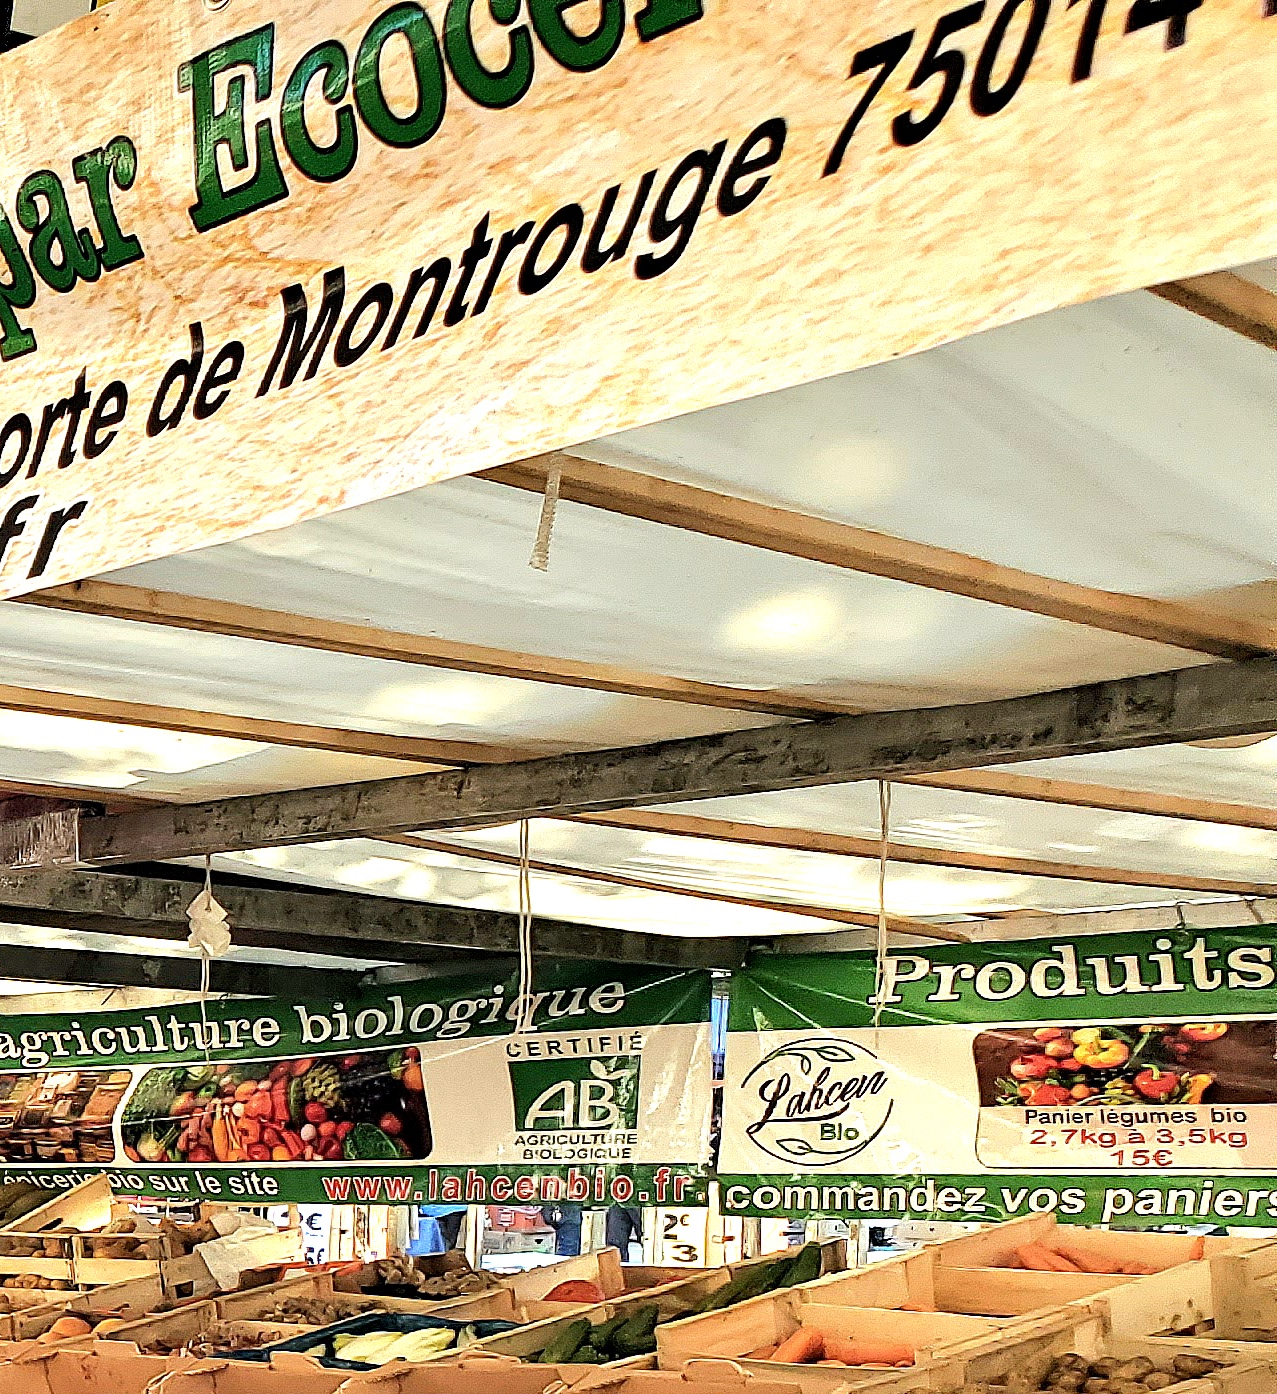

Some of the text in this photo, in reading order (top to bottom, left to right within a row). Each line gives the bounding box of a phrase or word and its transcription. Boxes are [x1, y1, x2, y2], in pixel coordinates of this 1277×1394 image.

[147, 322, 244, 438] de
[257, 115, 787, 398] Montrouge
[870, 937, 1276, 1003] Produits
[293, 980, 626, 1043] biologique
[507, 1031, 643, 1057] CERTIFIÉ
[524, 1079, 619, 1129] AB
[754, 1068, 888, 1126] Lahcen
[1025, 1107, 1247, 1129] Panier légumes bio
[514, 1133, 638, 1146] AGRICULTURE
[1030, 1127, 1248, 1149] 2,7kg à 3,5kg
[1110, 1149, 1173, 1167] 15€
[150, 1175, 191, 1193] sur
[195, 1171, 222, 1194] le
[228, 1171, 280, 1196] site
[322, 1167, 689, 1201] www.lahcenbio.fr
[725, 1180, 987, 1214] commandez
[1000, 1185, 1085, 1215] vos
